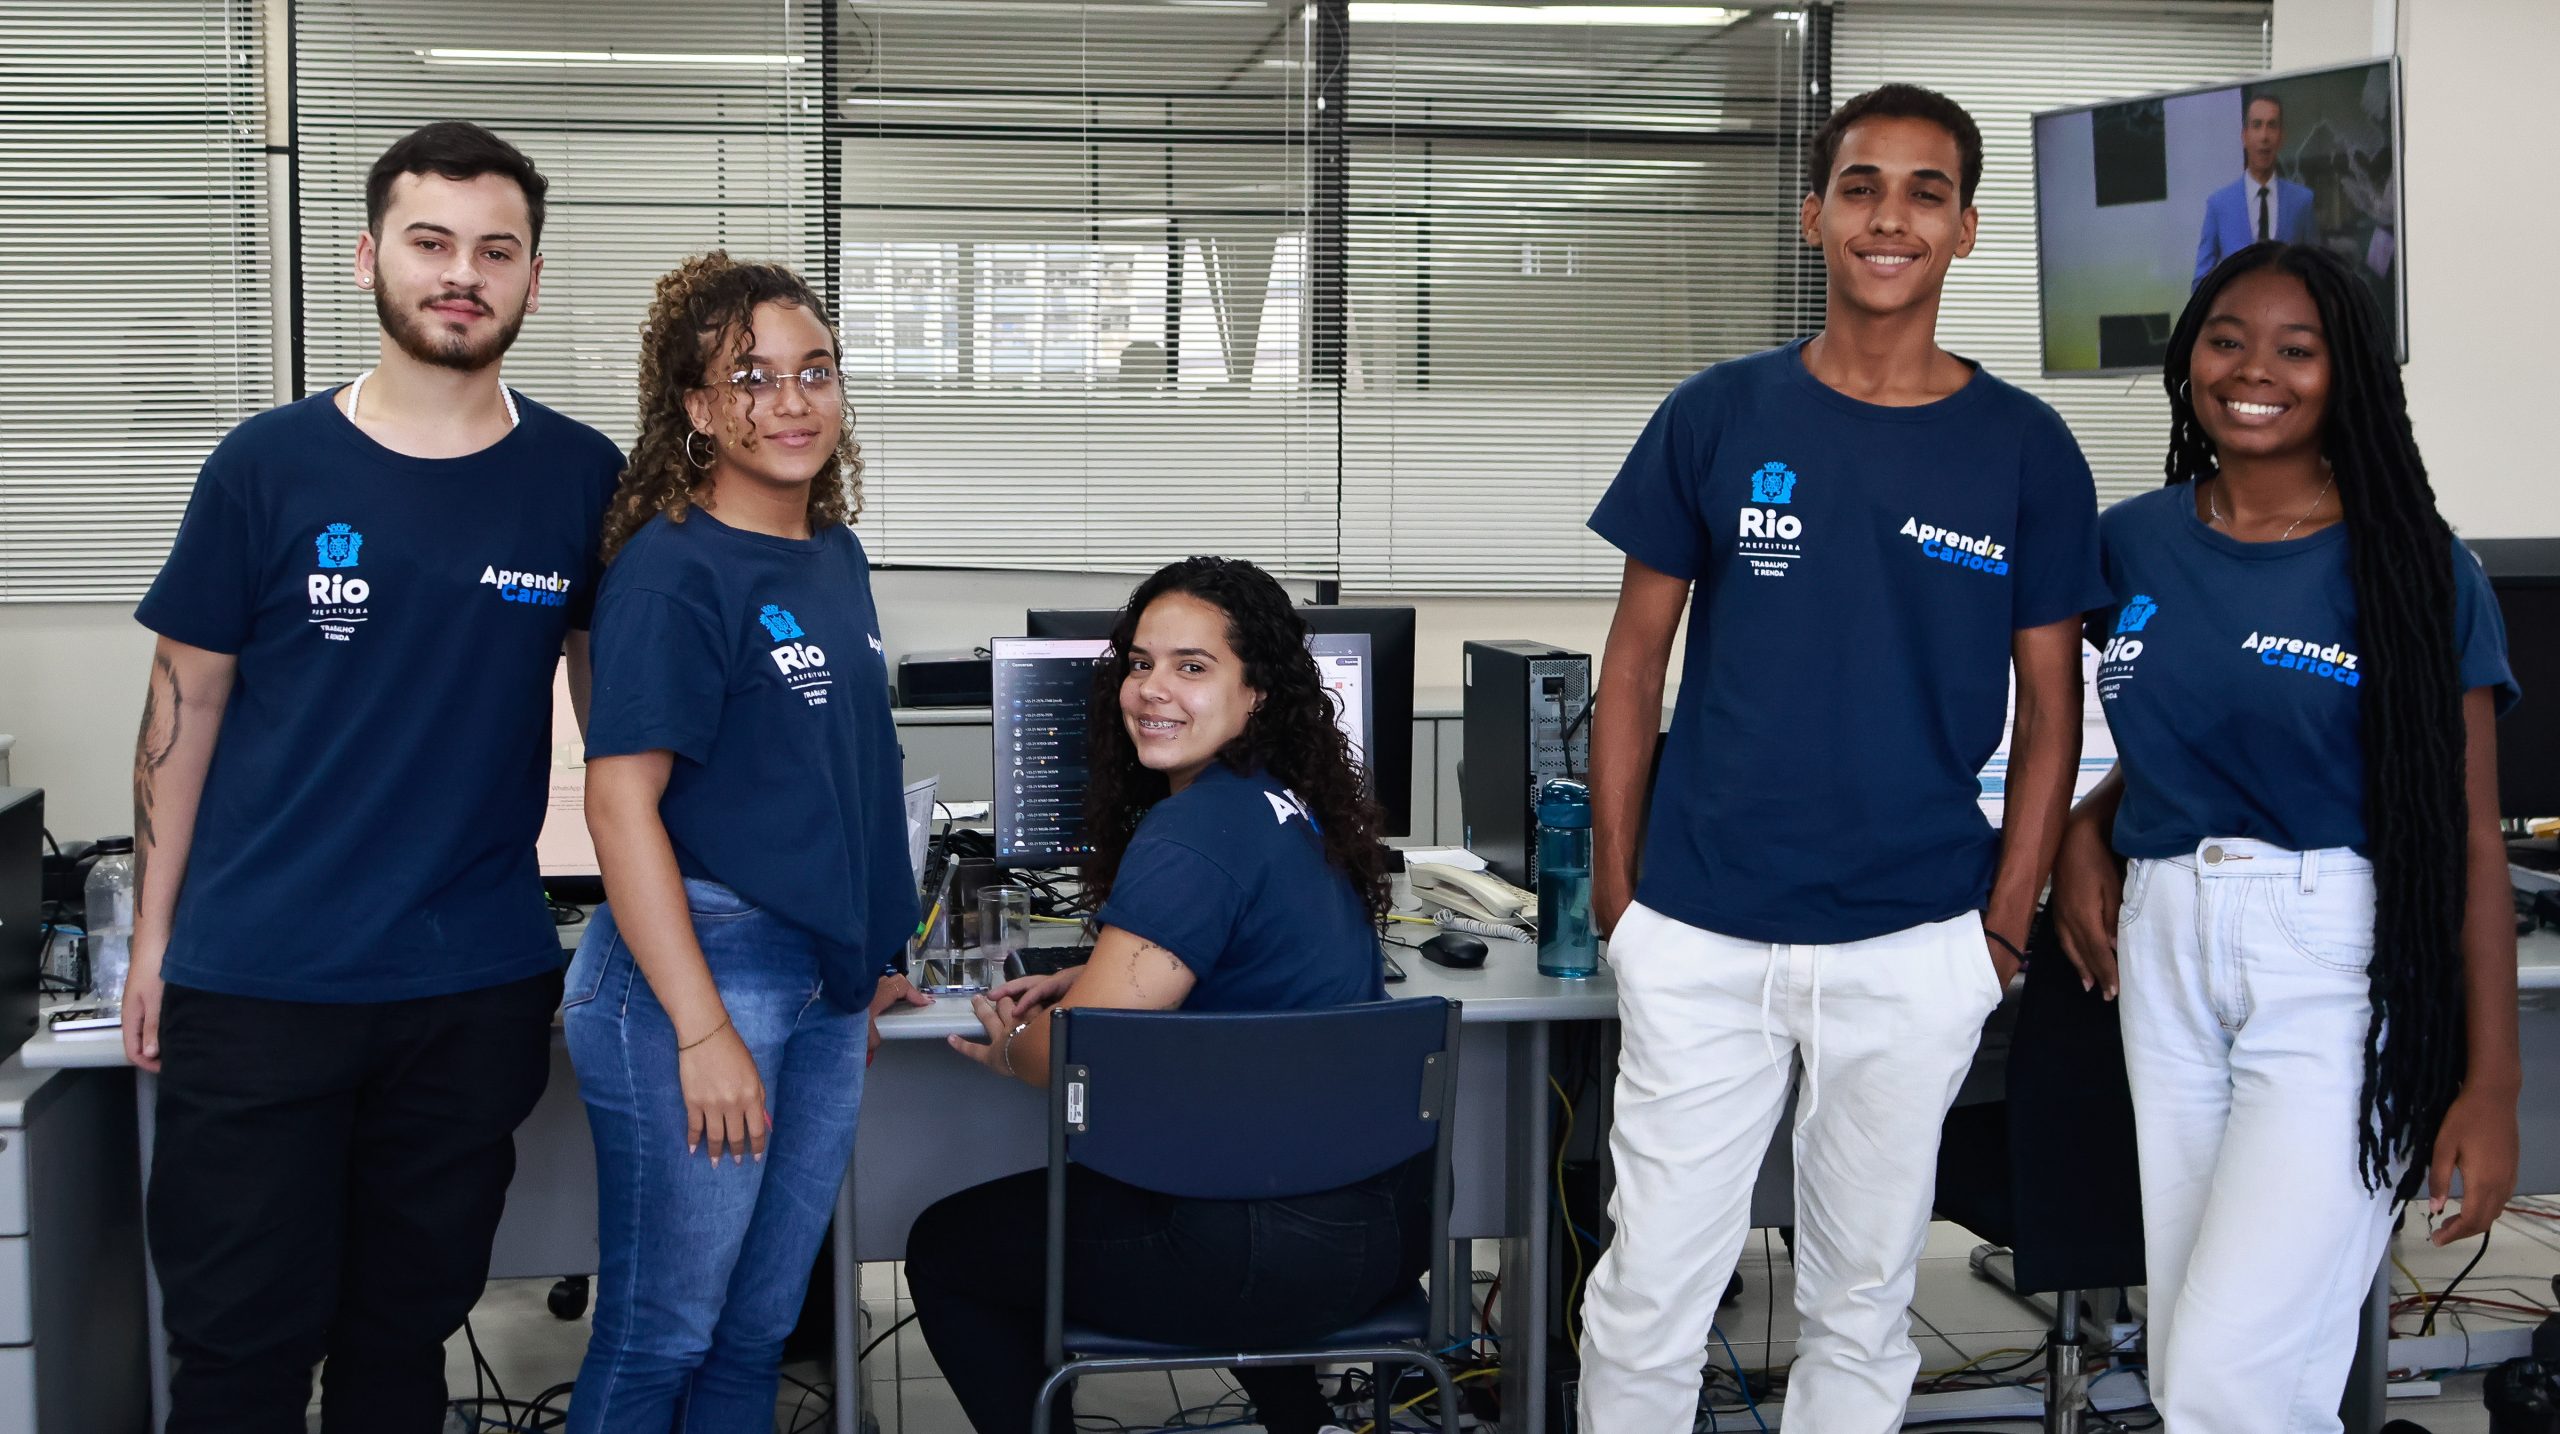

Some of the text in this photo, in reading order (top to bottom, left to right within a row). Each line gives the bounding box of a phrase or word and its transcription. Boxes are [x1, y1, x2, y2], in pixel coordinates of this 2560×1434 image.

[1740, 507, 1802, 540] Rio
[1899, 516, 2006, 560] Aprendiz
[1739, 542, 1801, 551] PREFEITURA
[1922, 539, 2009, 576] Carioca
[480, 565, 571, 593] Aprendiz
[1750, 560, 1789, 569] TRABALHO
[1760, 569, 1785, 577] RENDA
[308, 573, 370, 605] Rio
[770, 642, 826, 675] Rio
[2241, 631, 2358, 670] Aprendiz
[2261, 648, 2360, 687] Carioca
